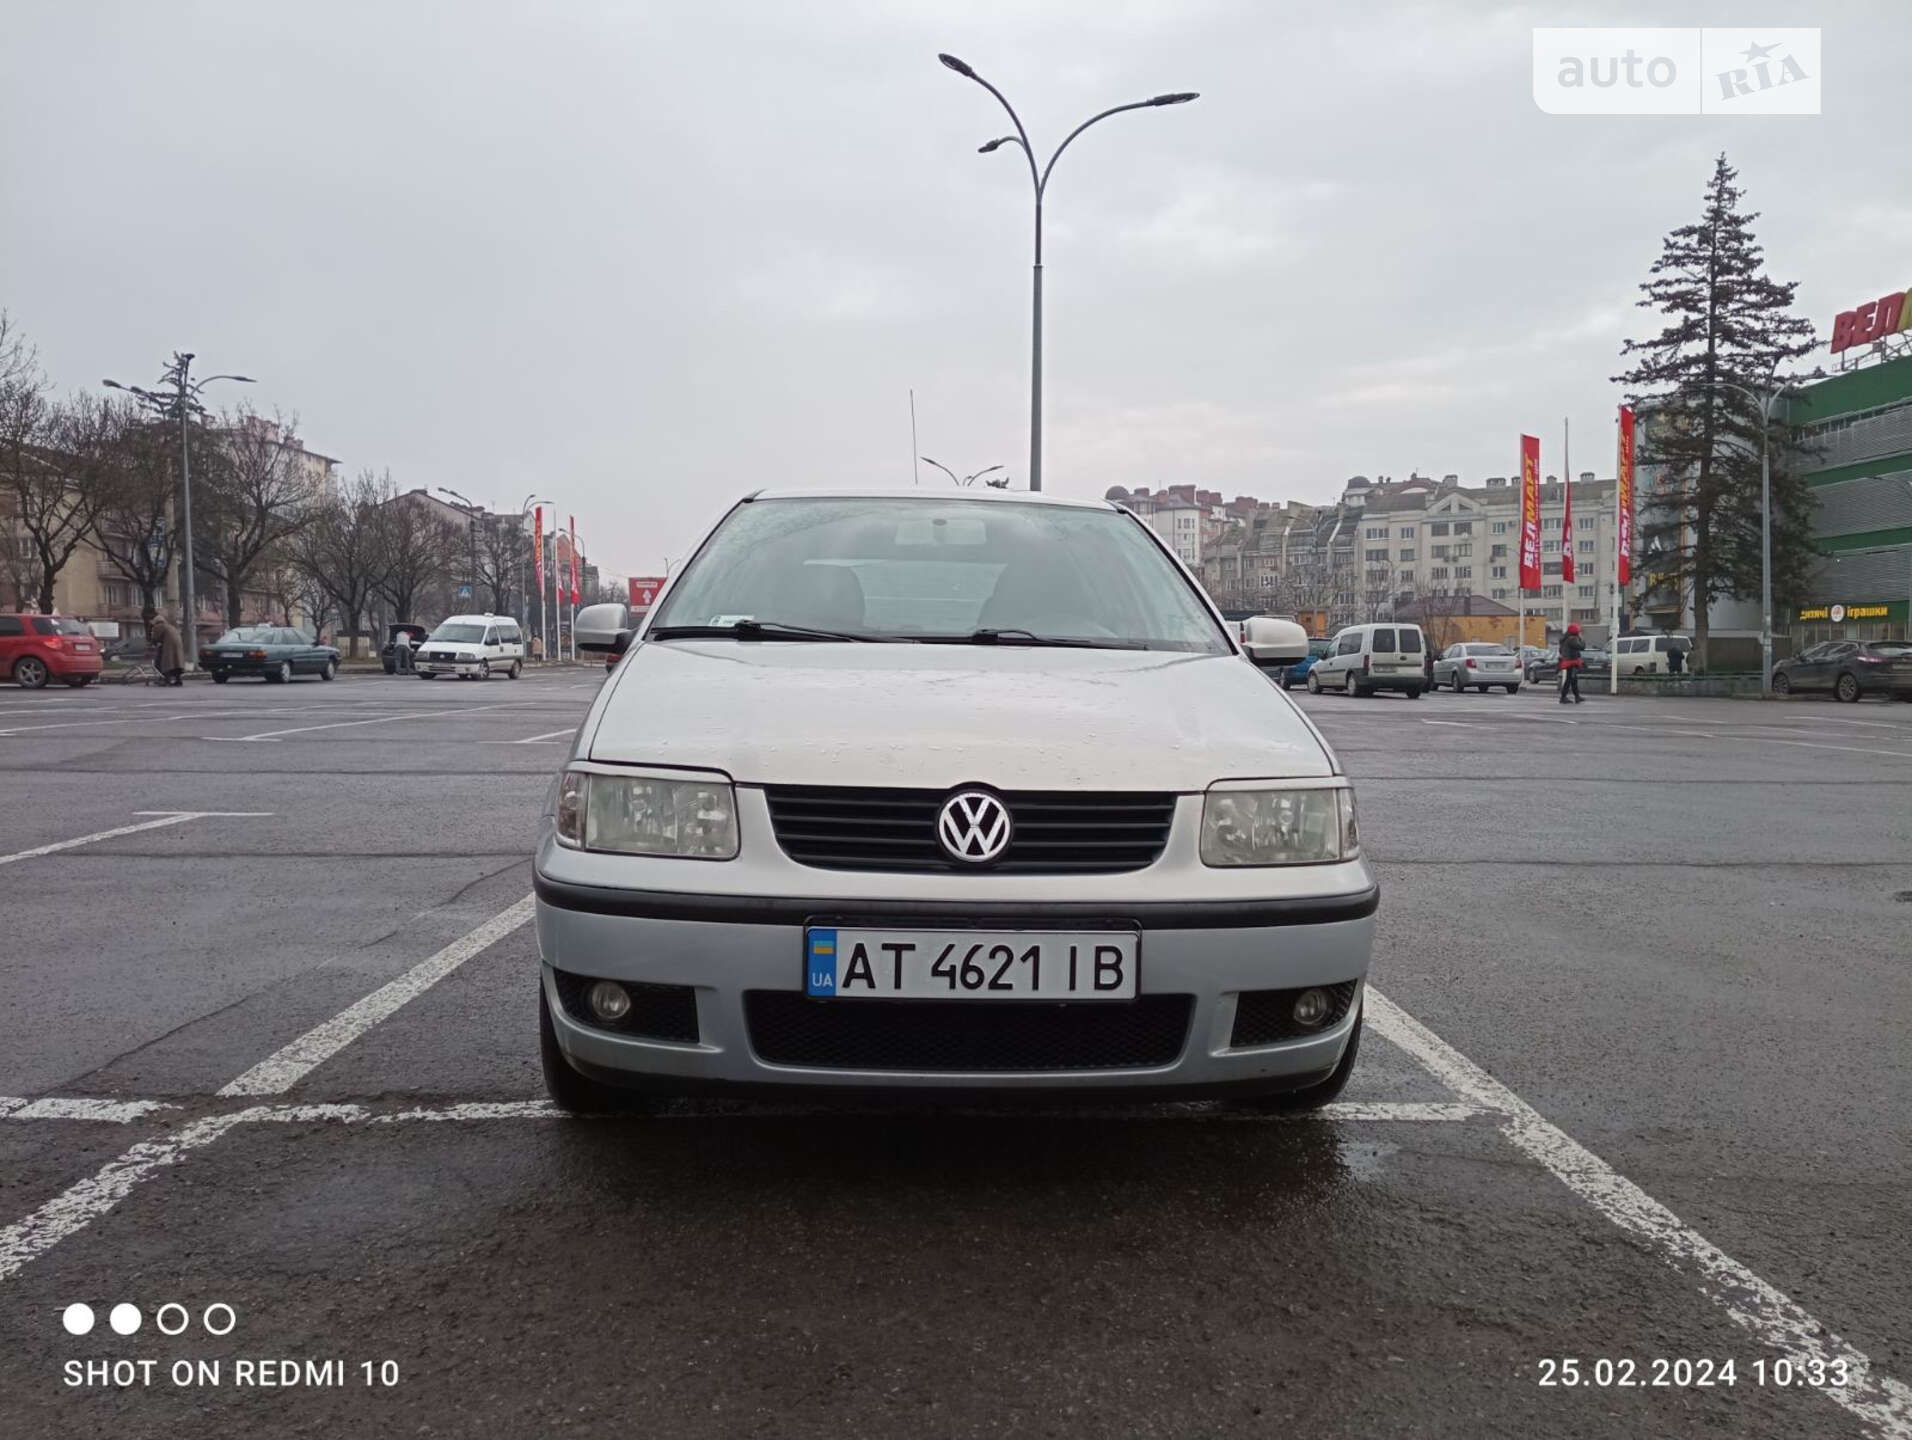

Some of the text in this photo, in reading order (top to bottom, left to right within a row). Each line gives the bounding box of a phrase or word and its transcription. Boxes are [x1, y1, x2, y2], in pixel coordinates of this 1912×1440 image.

[1524, 452, 1537, 569] ВЕЛМАРТ
[812, 973, 833, 987] UA
[842, 943, 1124, 991] AT 4621 IB
